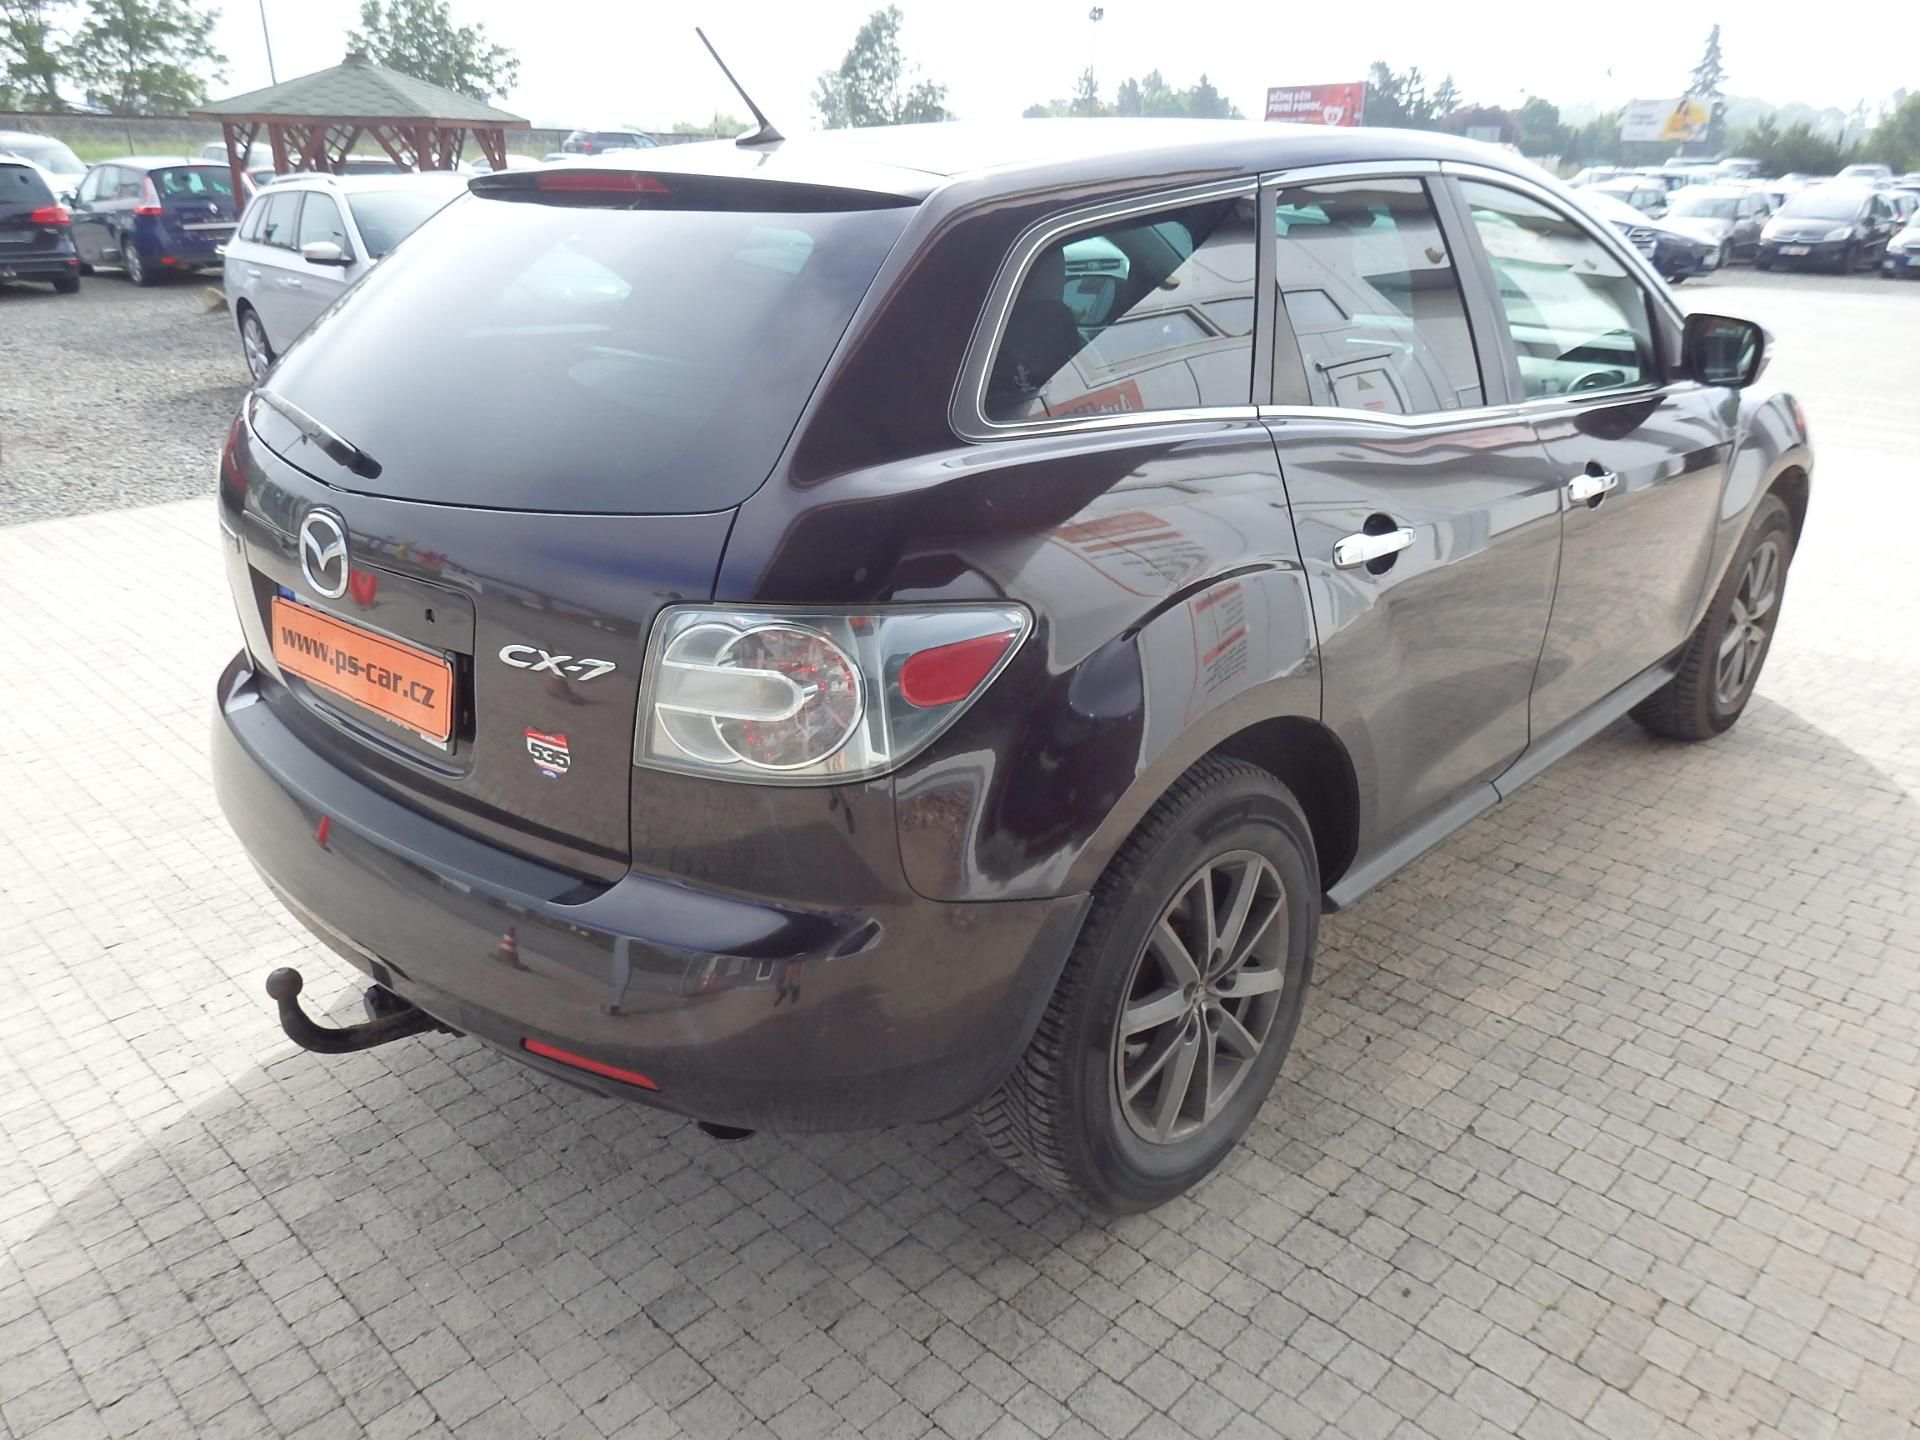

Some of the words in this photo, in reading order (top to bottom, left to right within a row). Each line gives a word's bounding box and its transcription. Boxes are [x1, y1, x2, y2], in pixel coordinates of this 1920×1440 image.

[281, 626, 435, 709] www.ps-car.cz
[499, 644, 617, 681] CX-7
[530, 742, 570, 768] 535
